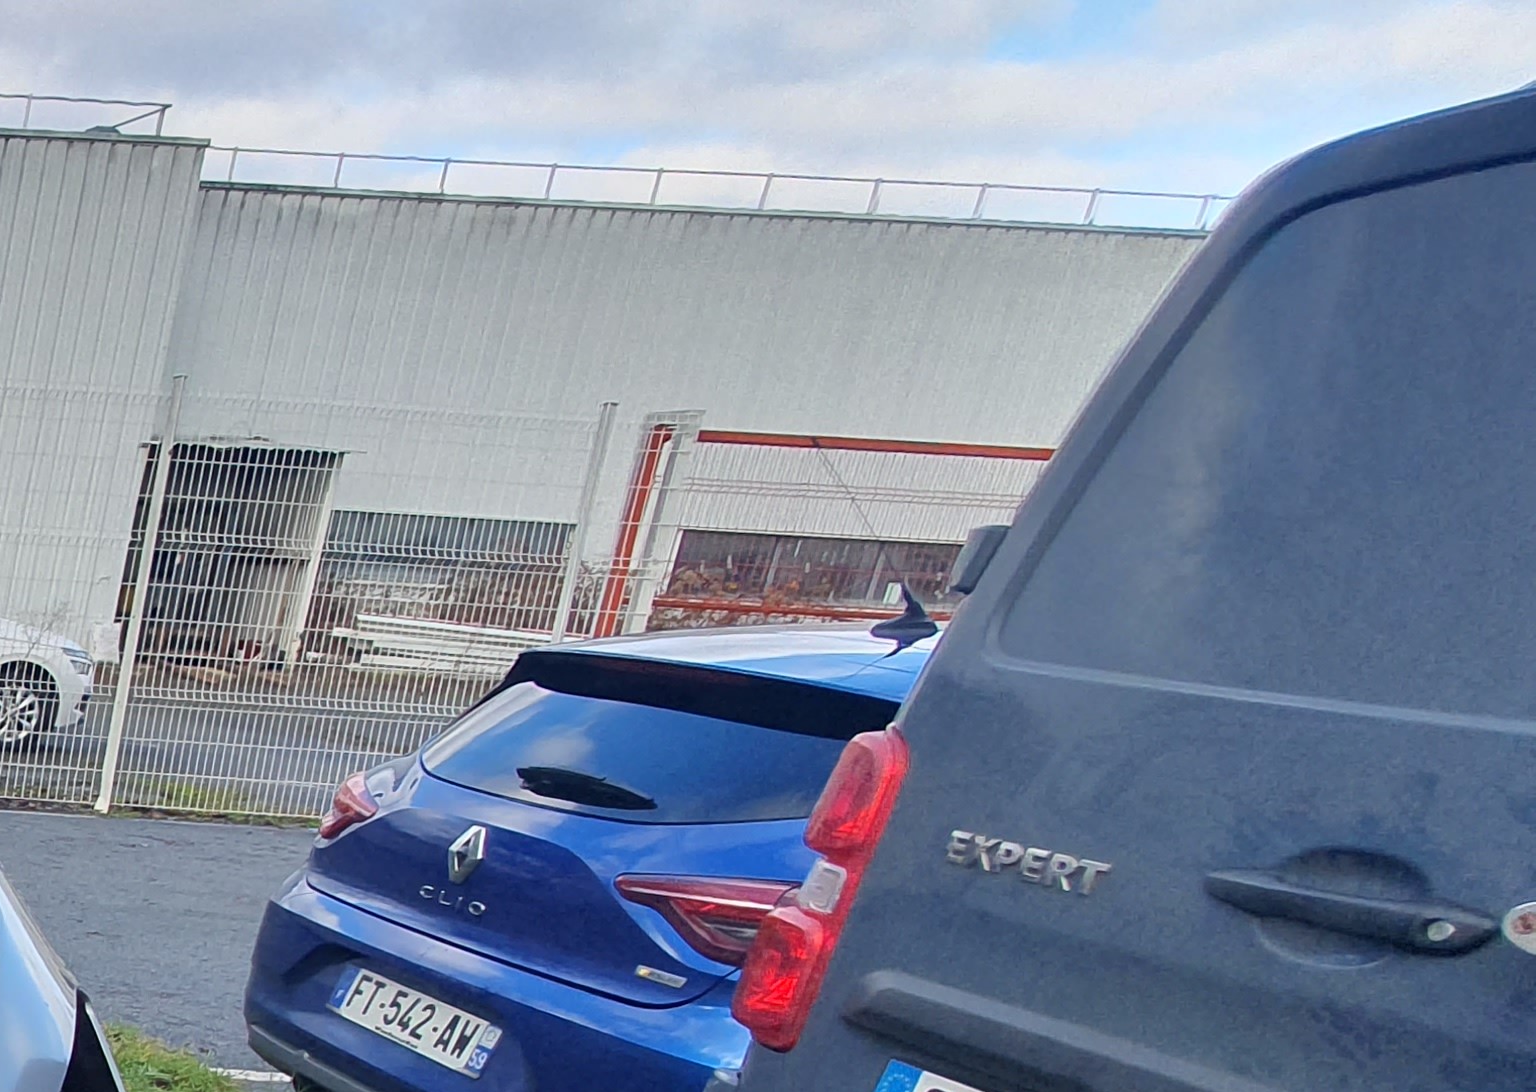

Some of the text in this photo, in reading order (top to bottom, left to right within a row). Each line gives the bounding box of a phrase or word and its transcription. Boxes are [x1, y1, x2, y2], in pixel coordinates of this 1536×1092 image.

[946, 829, 1112, 896] EXPERT
[419, 885, 486, 916] CLIO
[345, 974, 480, 1060] FT-542-AW
[468, 1049, 488, 1070] 59
